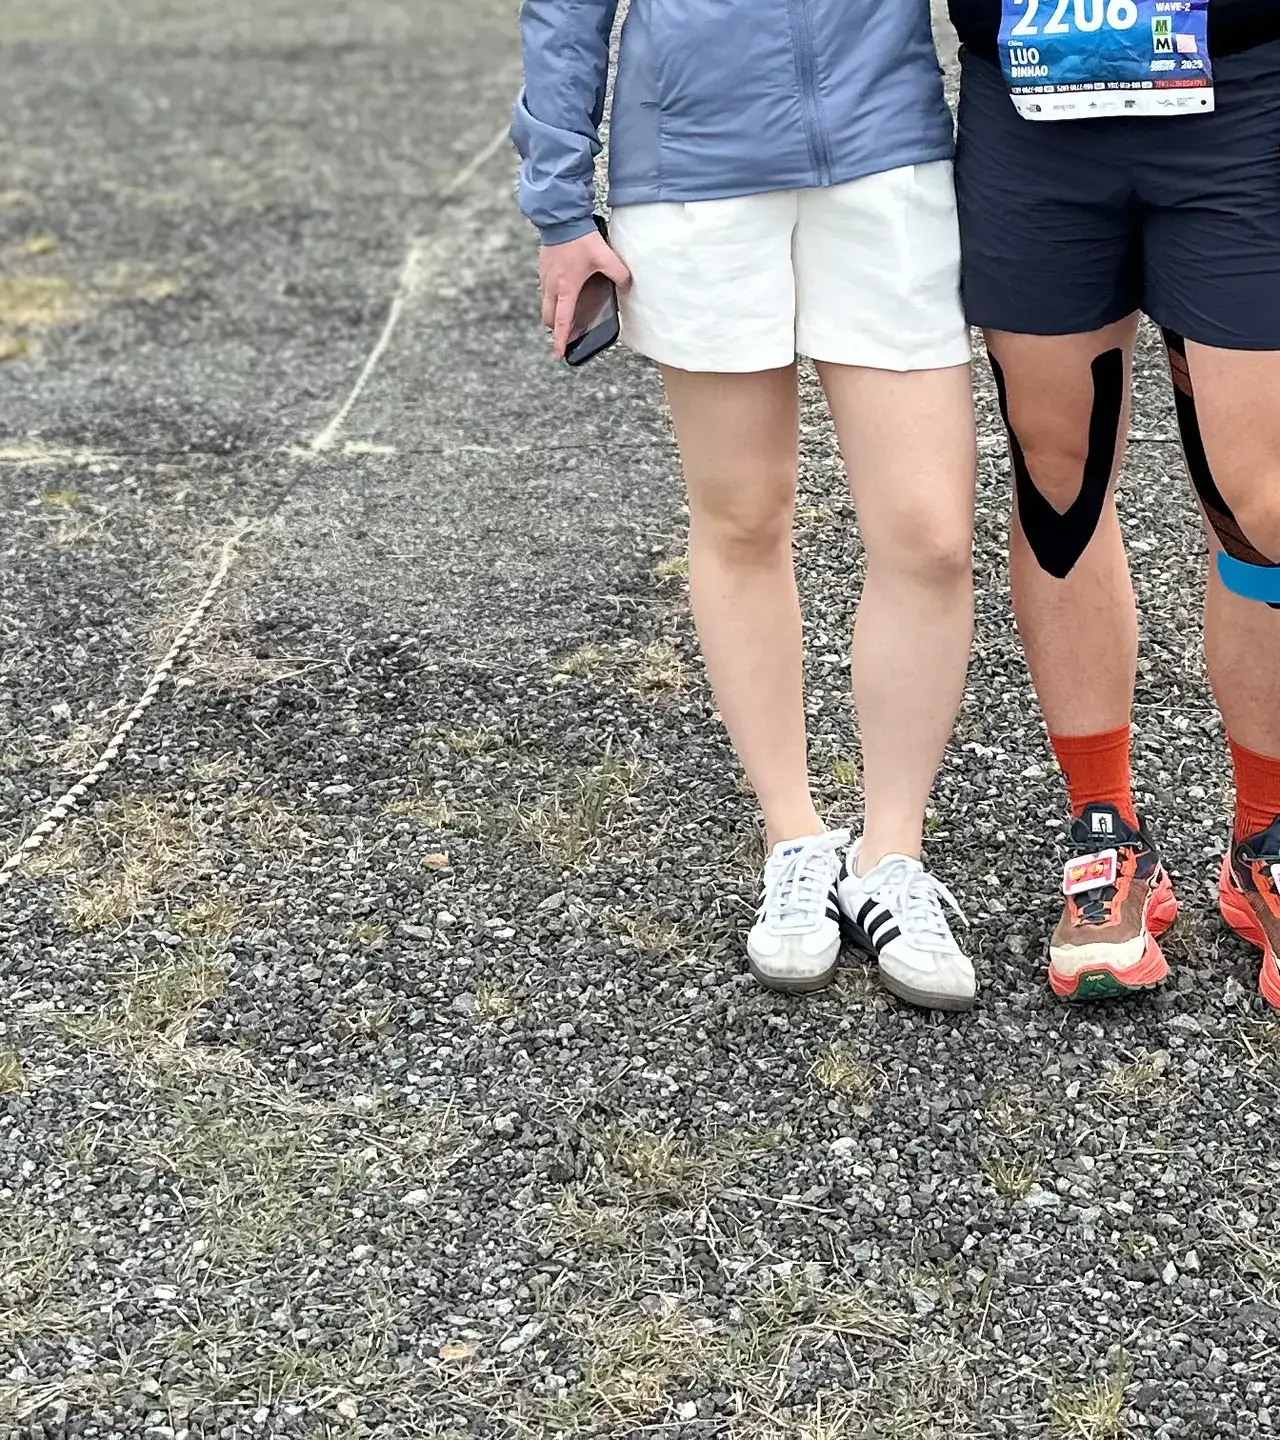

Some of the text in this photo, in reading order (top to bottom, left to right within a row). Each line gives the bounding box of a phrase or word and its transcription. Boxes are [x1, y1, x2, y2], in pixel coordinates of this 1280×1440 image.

[1155, 2, 1191, 12] WAVE-2
[1155, 37, 1171, 51] M
[1009, 47, 1040, 65] LUO
[1011, 64, 1048, 78] BINHAO
